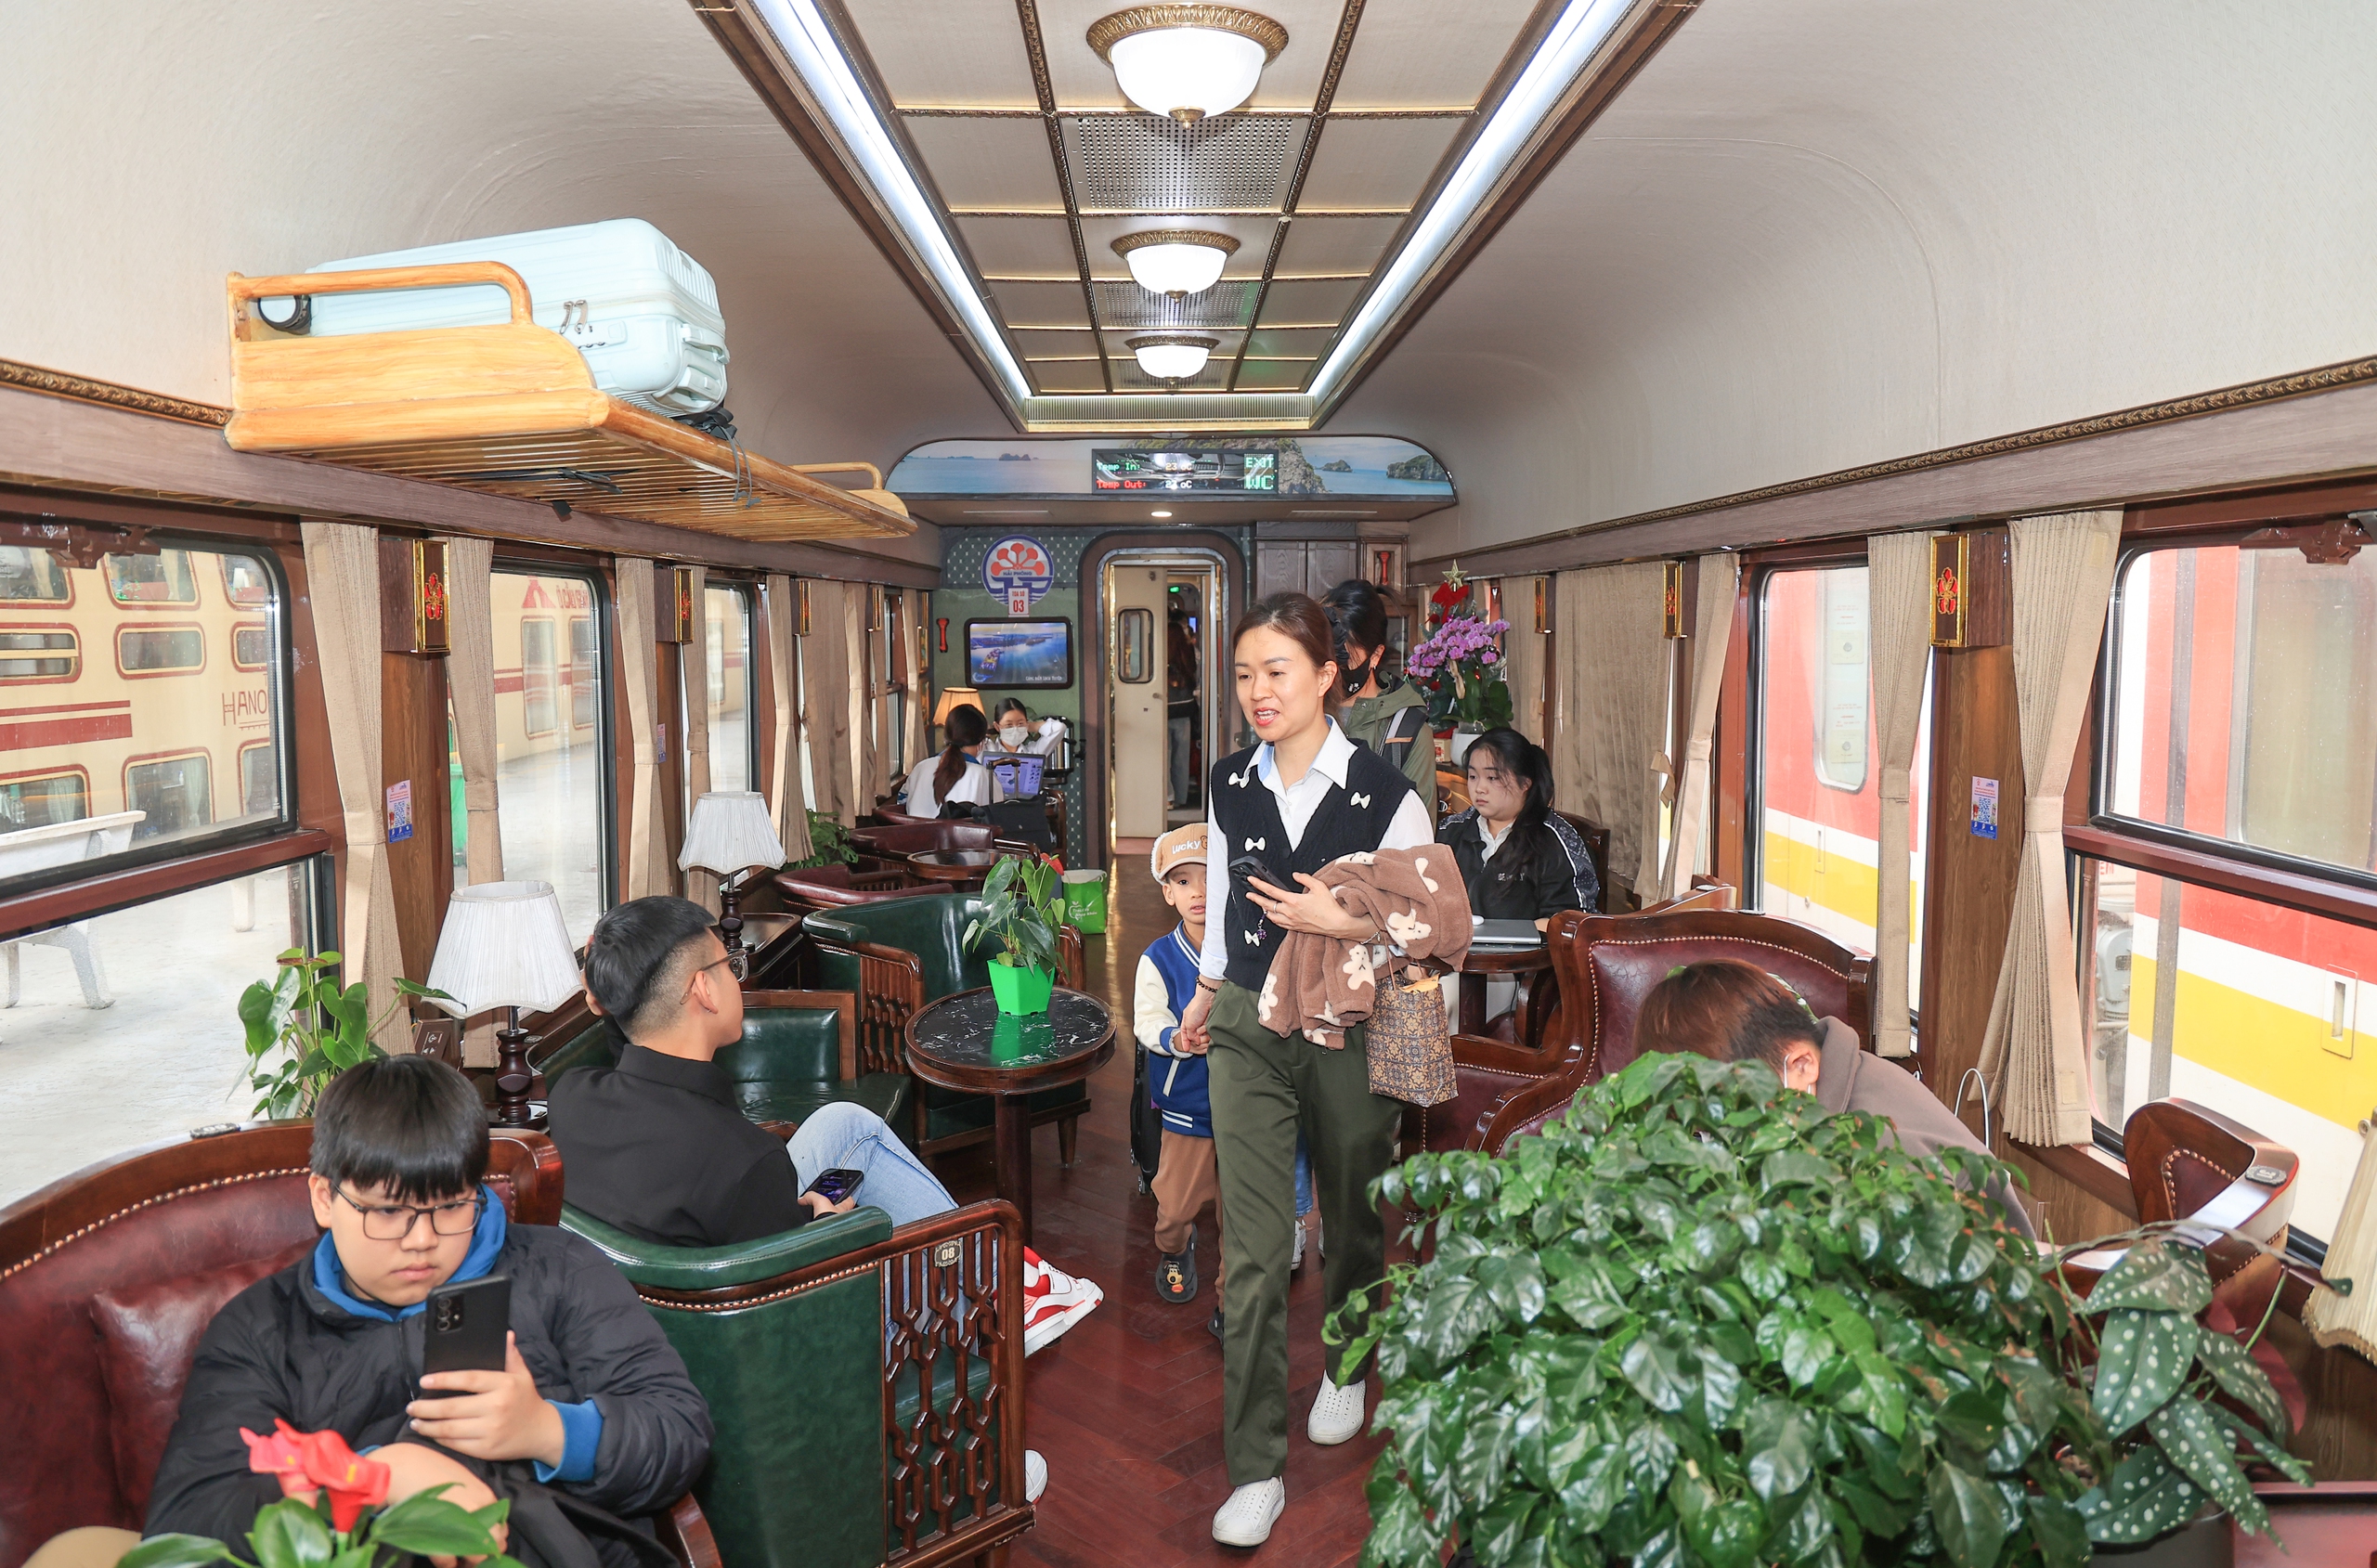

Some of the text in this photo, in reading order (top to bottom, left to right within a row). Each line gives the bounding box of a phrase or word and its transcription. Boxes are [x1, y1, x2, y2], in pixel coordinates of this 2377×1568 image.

[1097, 462, 1120, 471] Temp
[1125, 462, 1141, 471] In:
[1164, 462, 1178, 471] 23
[1245, 457, 1275, 469] EXIT
[1097, 480, 1120, 489] Temp
[1124, 480, 1148, 489] Out:
[1245, 475, 1275, 490] WC
[1013, 600, 1024, 613] 03
[941, 1247, 955, 1261] 08
